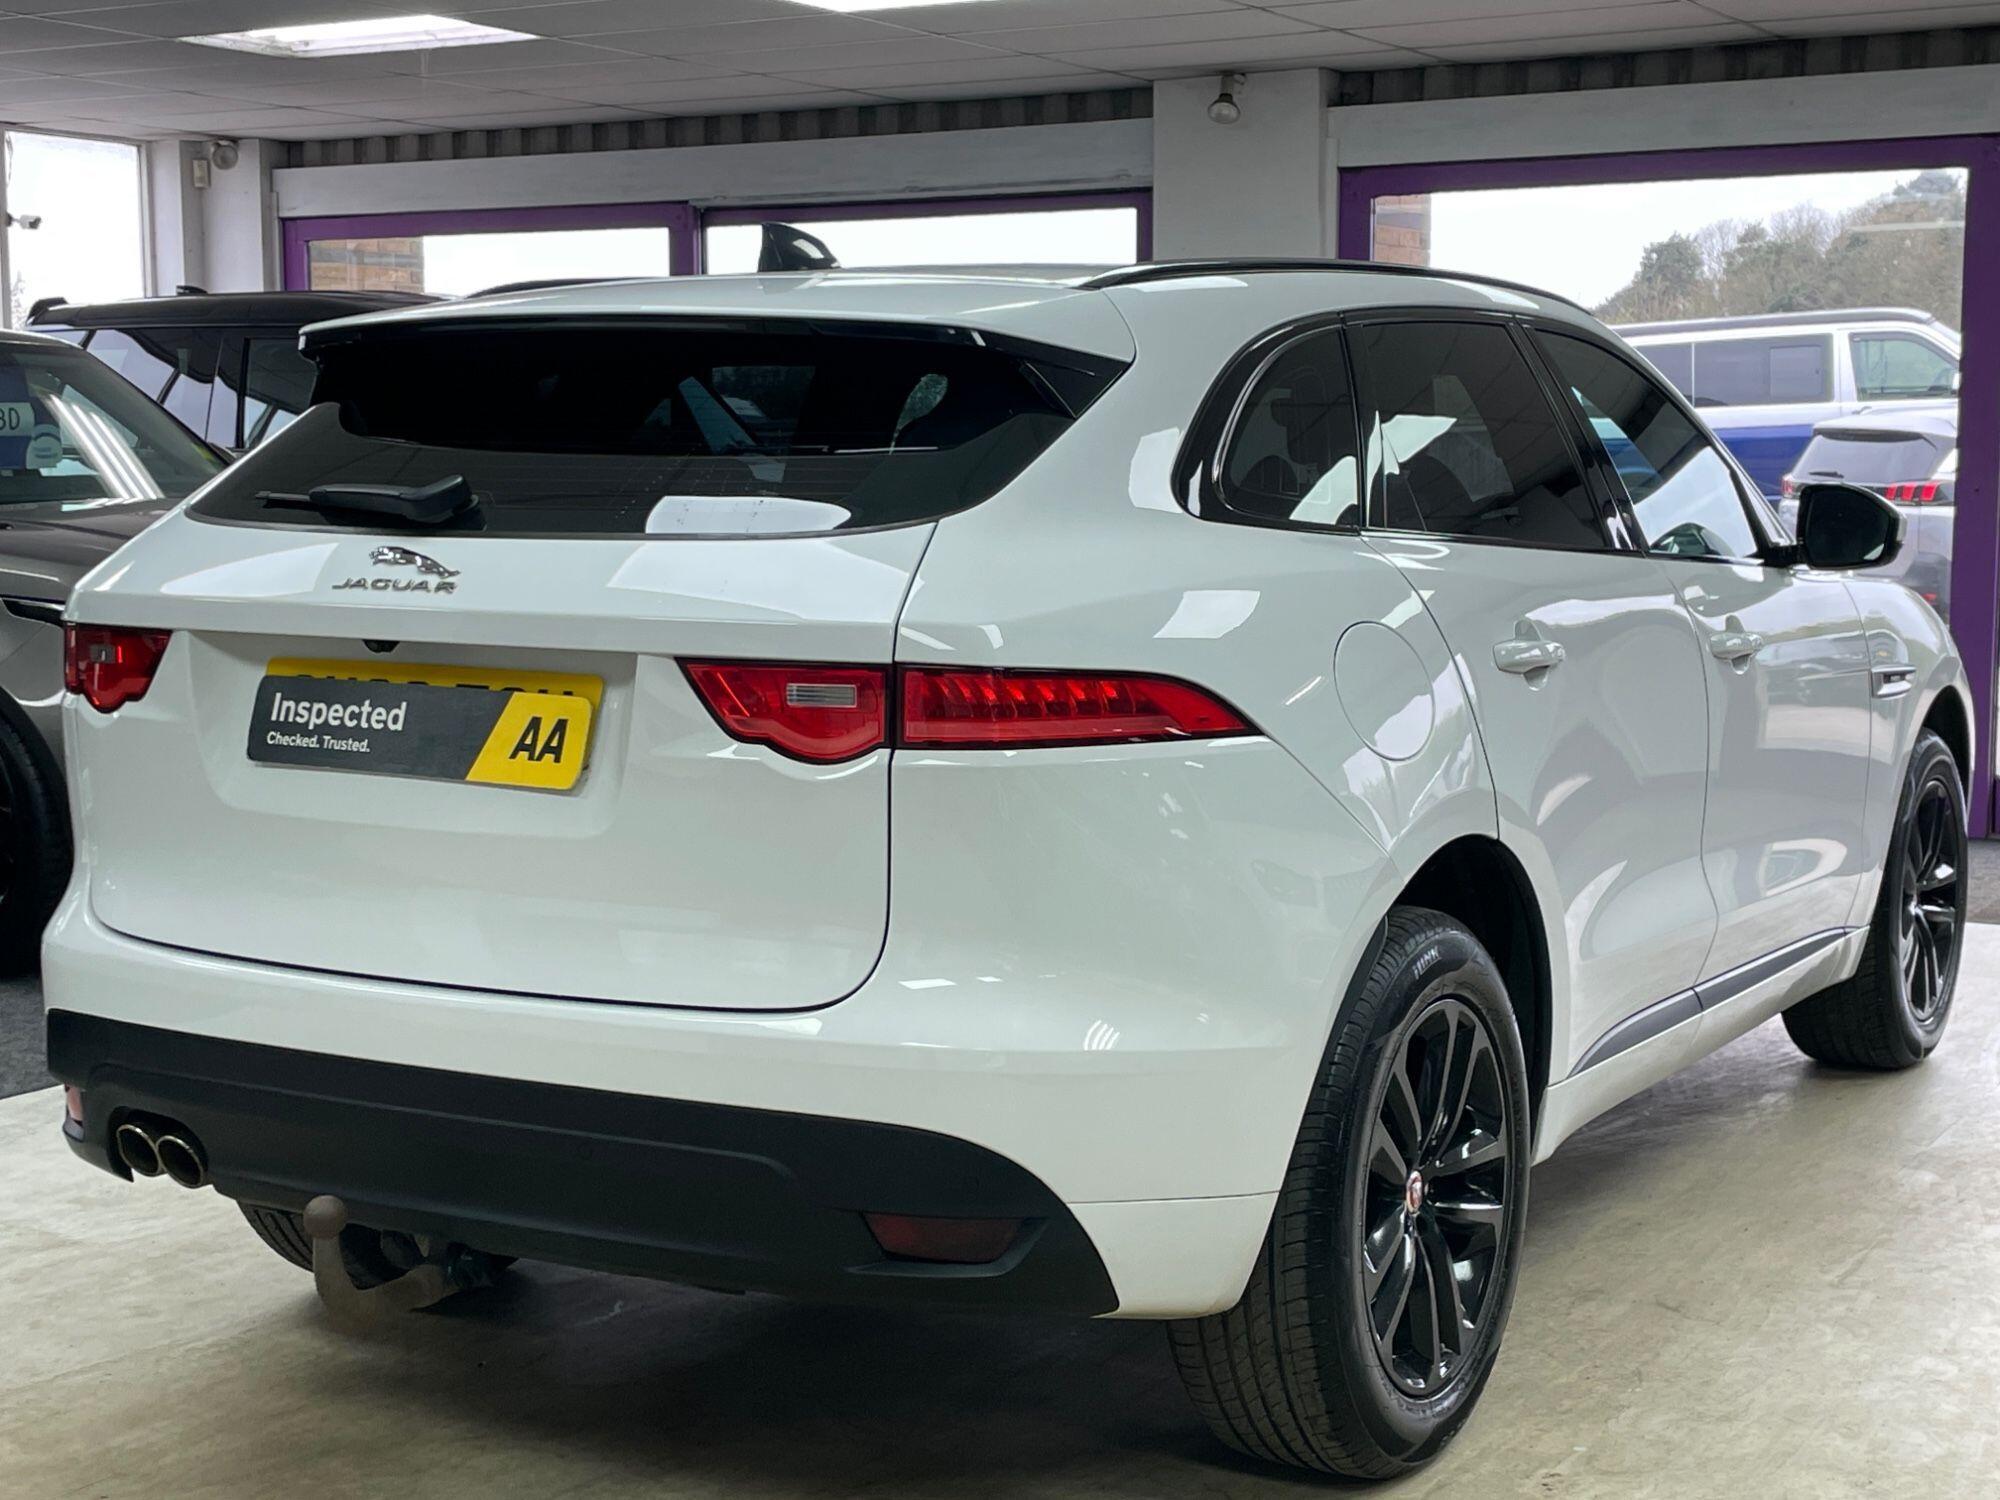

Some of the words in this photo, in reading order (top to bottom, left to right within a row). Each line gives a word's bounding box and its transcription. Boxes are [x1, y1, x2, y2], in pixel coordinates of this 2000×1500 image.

[331, 577, 458, 595] JAGUAR
[270, 692, 408, 732] Inspected
[266, 731, 320, 749] Checked.
[322, 735, 371, 753] Trusted.
[508, 716, 569, 764] AA
